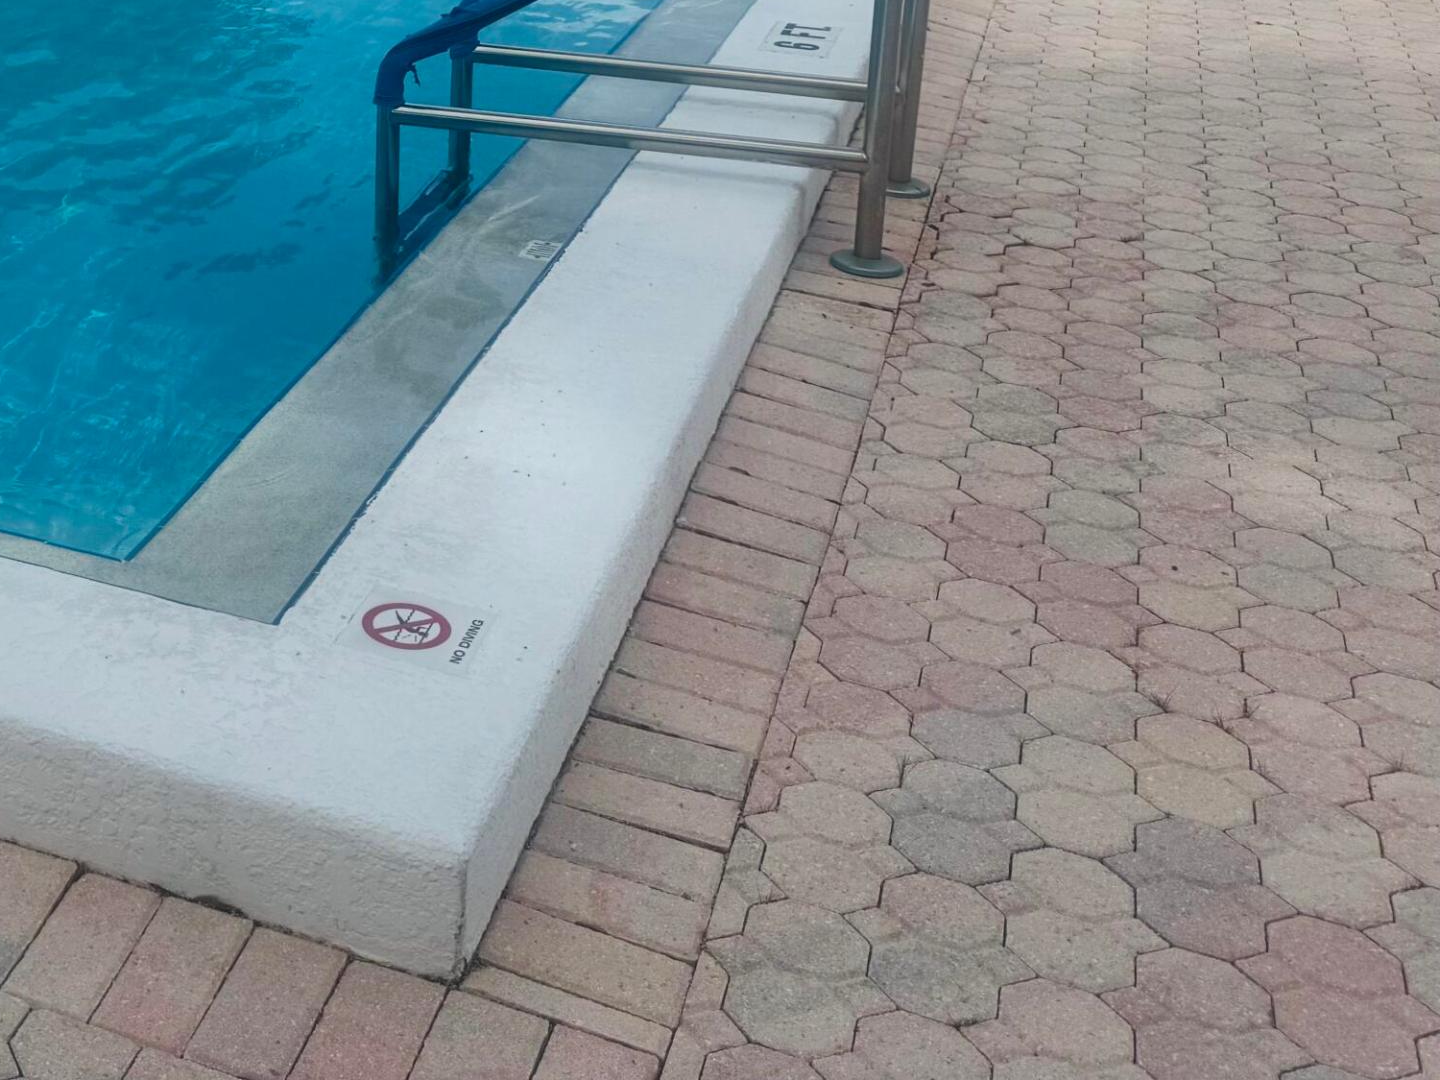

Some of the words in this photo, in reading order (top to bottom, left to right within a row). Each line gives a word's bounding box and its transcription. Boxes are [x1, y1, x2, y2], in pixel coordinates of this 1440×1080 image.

[781, 22, 832, 40] FT
[773, 40, 820, 51] 6
[449, 649, 466, 664] NO
[458, 619, 485, 649] DIVING
